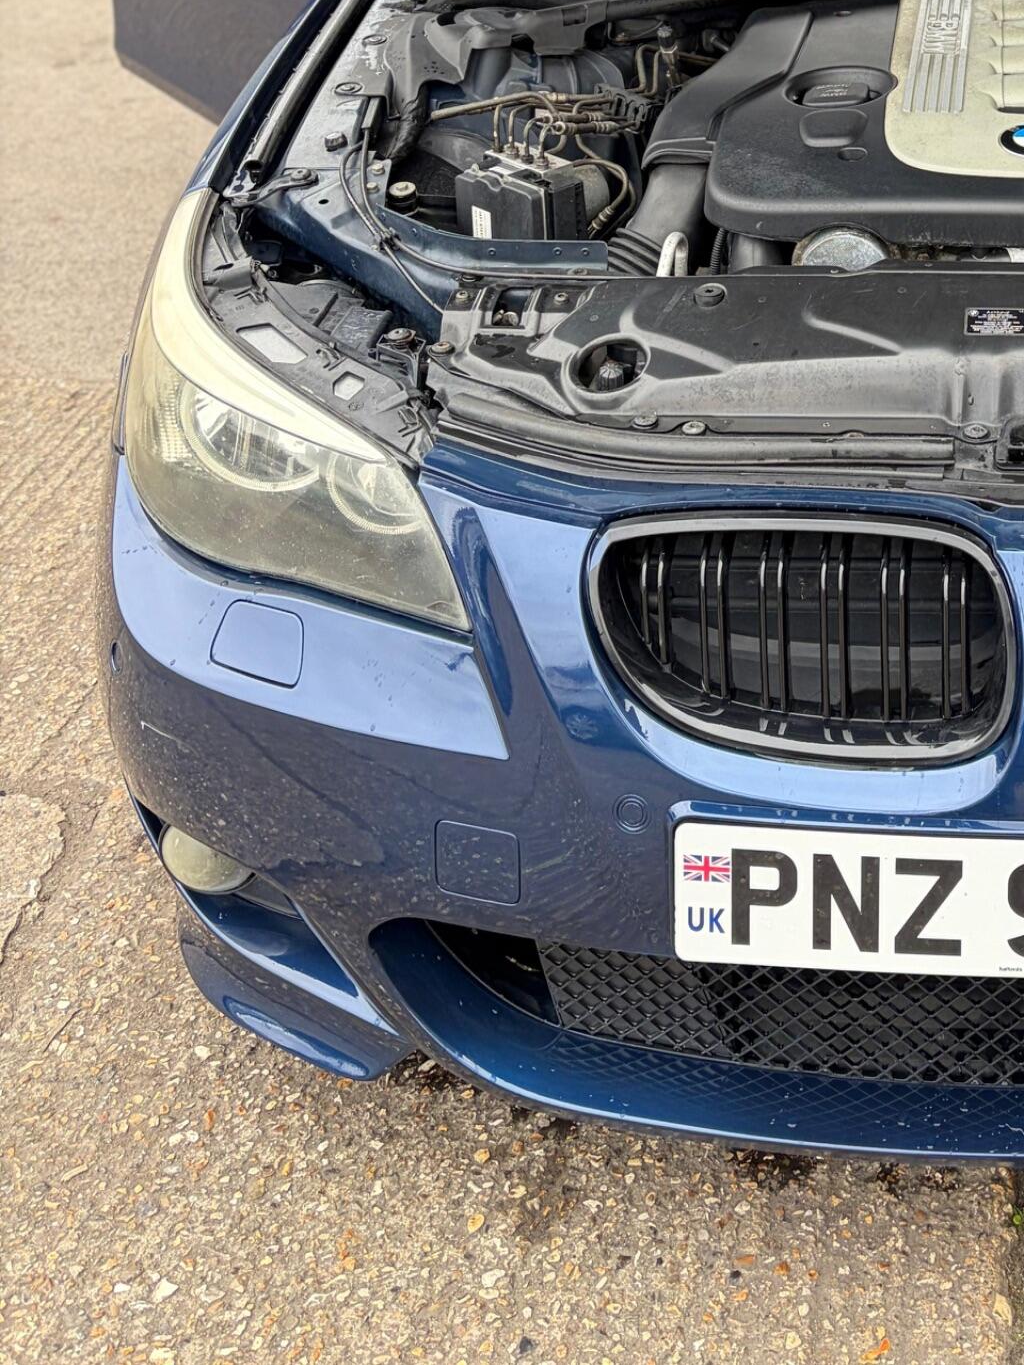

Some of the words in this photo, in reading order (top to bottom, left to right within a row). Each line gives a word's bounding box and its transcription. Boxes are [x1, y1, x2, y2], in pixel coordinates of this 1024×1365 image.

[923, 20, 960, 55] BMW
[687, 906, 725, 934] UK
[731, 848, 963, 957] PNZ
